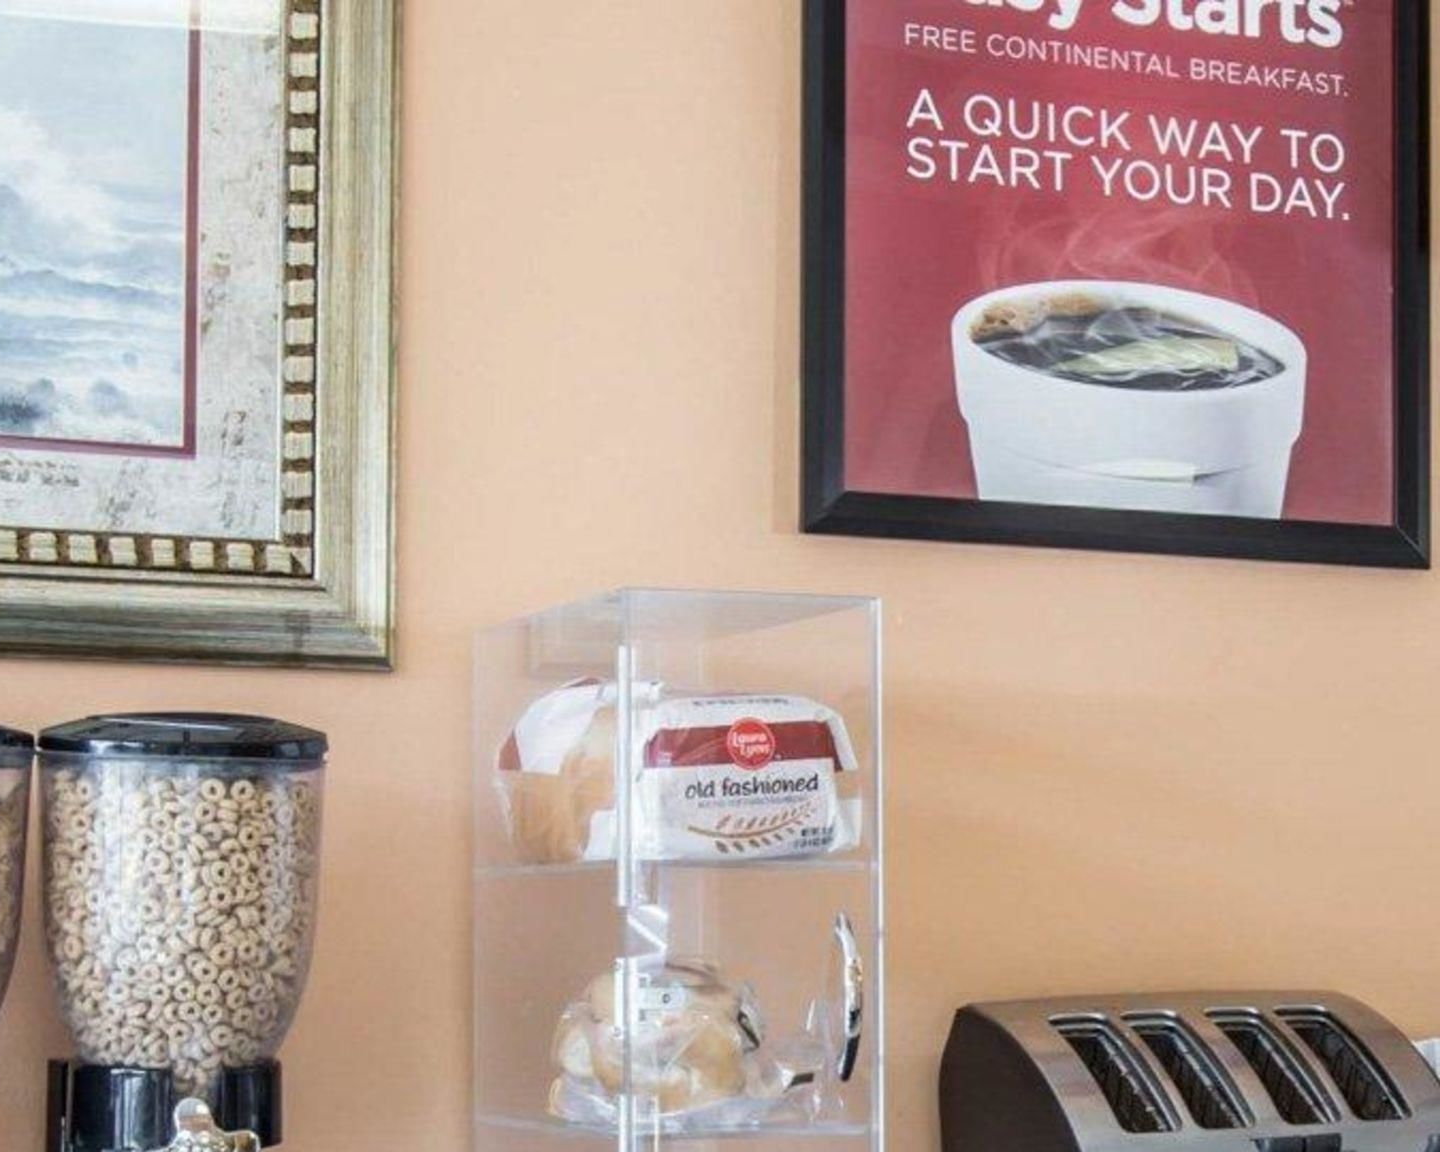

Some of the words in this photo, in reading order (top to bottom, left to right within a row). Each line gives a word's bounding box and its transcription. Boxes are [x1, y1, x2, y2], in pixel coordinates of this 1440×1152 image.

[904, 23, 977, 54] FREE
[986, 33, 1180, 78] CONTINENTAL
[1189, 57, 1349, 98] BREAKFAST.
[906, 88, 944, 131] A
[963, 94, 1132, 150] QUICK
[1147, 114, 1263, 164] WAY
[1280, 128, 1345, 173] TO
[906, 136, 1073, 191] START
[1090, 154, 1232, 209] YOUR
[1249, 172, 1350, 221] DAY.
[684, 780, 716, 799] old
[722, 773, 819, 797] fashioned
